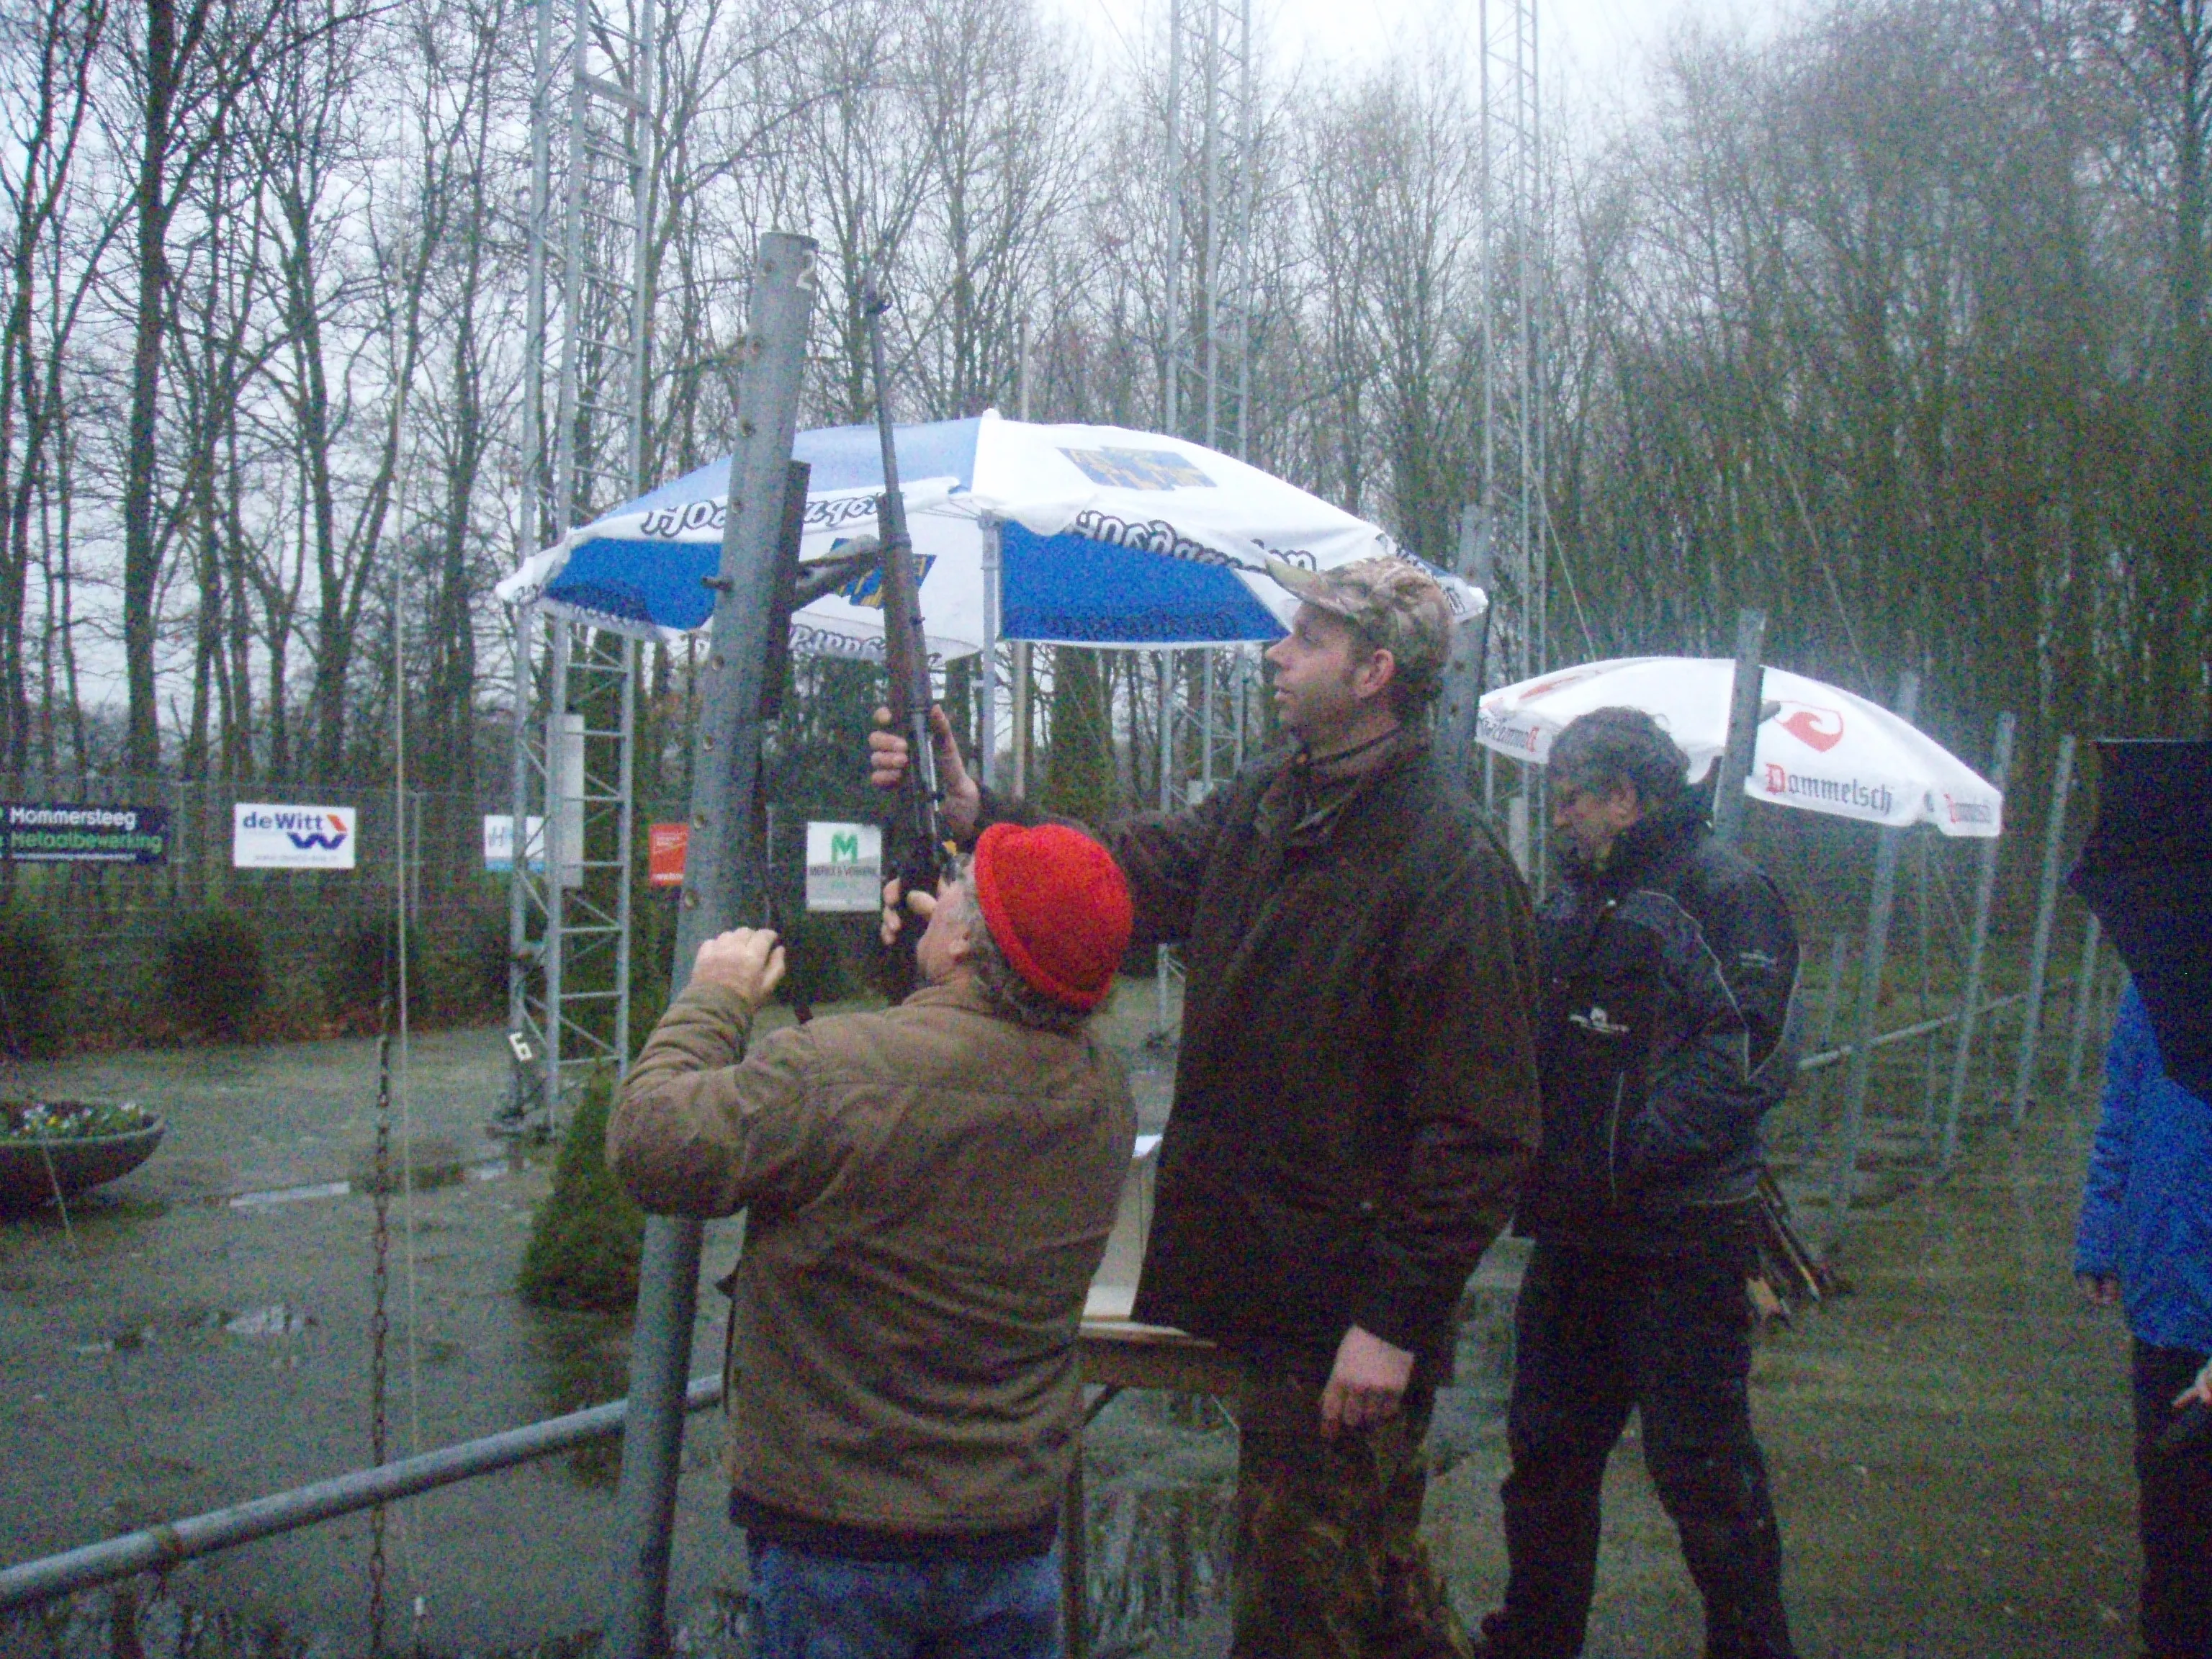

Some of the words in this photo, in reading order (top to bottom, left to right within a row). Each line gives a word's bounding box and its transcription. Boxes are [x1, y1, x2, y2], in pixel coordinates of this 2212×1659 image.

[796, 249, 817, 290] 2
[1765, 763, 1893, 816] Dommelsch
[508, 1031, 533, 1062] 6
